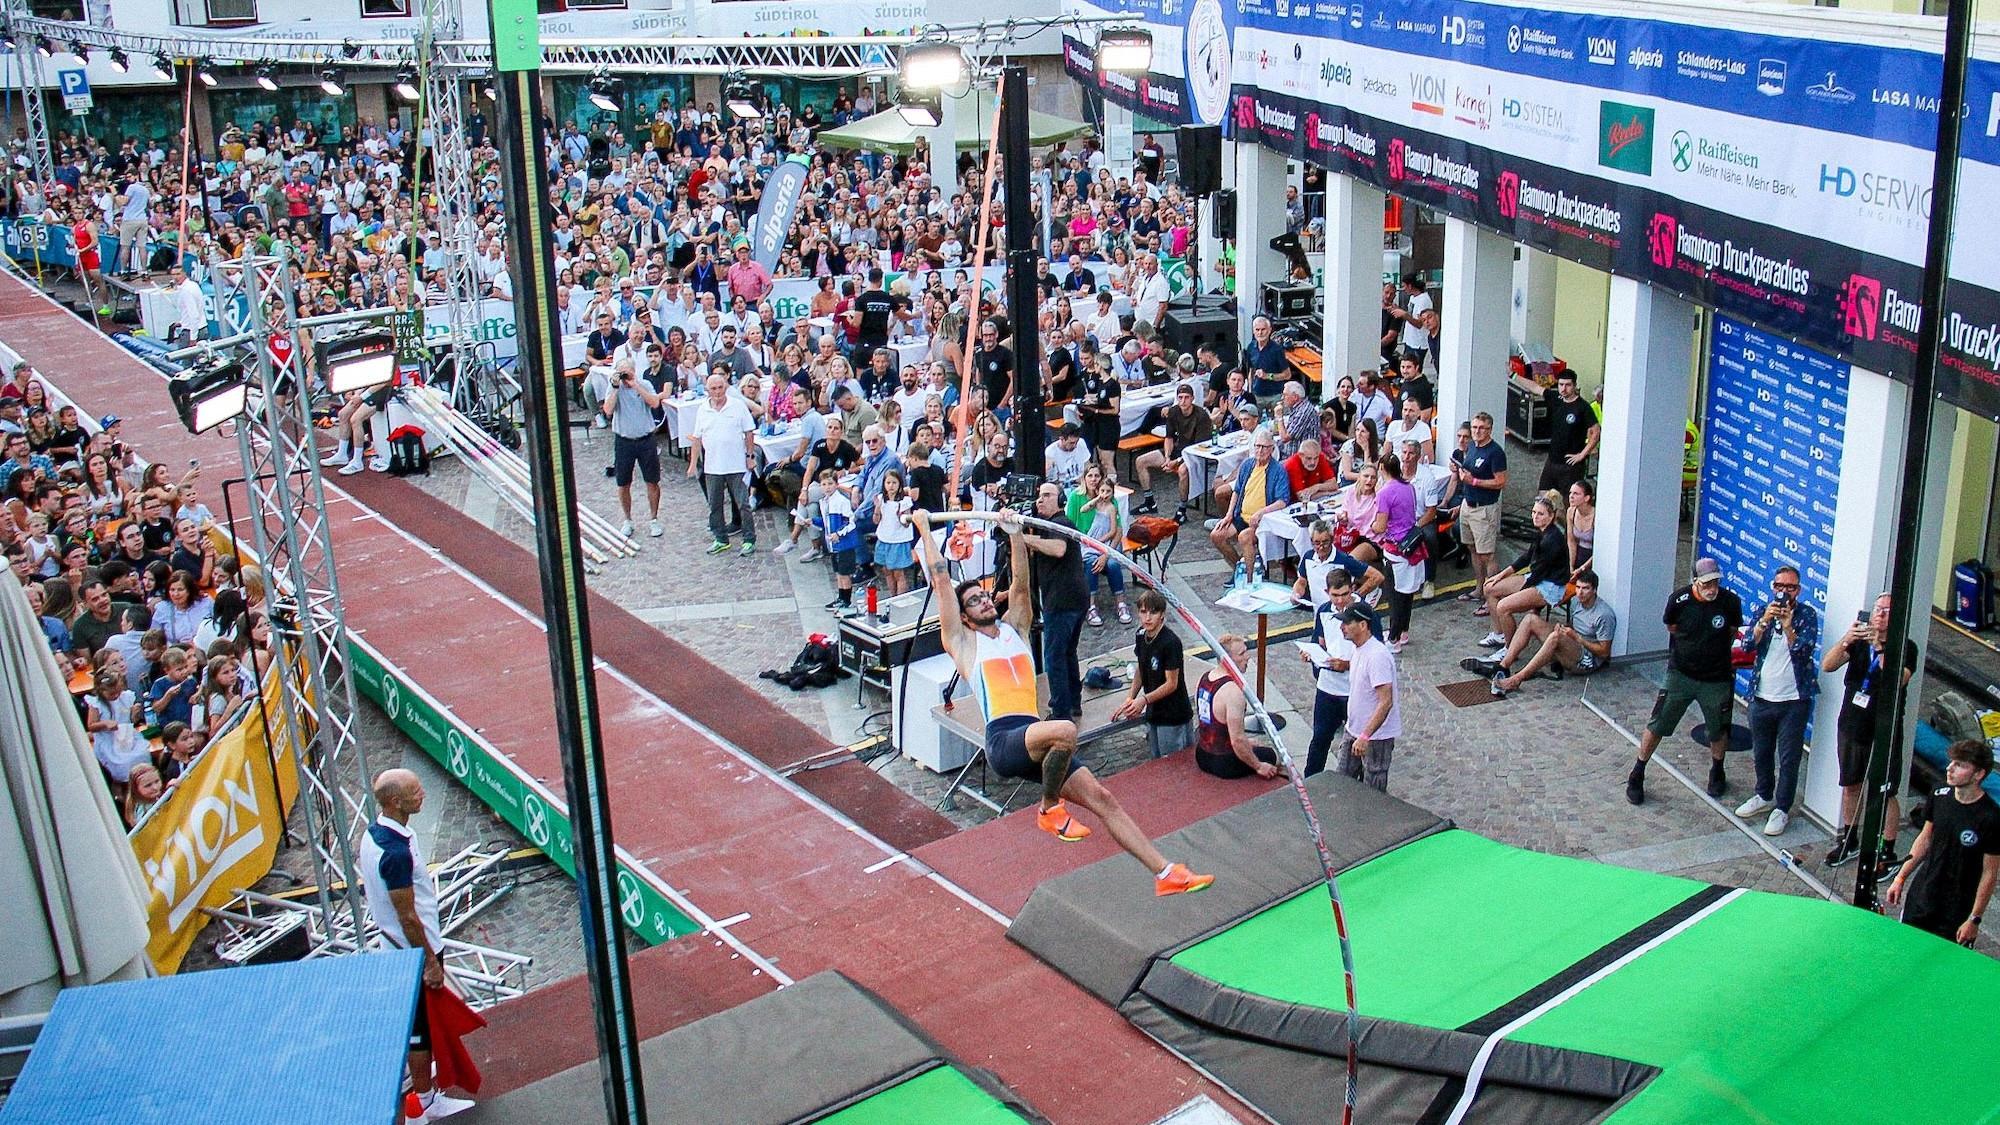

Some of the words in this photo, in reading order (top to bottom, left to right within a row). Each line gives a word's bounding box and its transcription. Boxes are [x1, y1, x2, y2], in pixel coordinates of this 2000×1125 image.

[1397, 21, 1413, 31] LASA
[1441, 16, 1466, 45] HD
[1523, 28, 1557, 45] Raiffeisen
[1588, 37, 1616, 58] VION
[1628, 47, 1664, 70] alperia
[1320, 57, 1352, 87] alperia
[1677, 51, 1746, 75] Schlanders-Laas
[64, 72, 82, 93] P
[1363, 77, 1397, 97] pedacta
[1410, 72, 1446, 104] VION
[1872, 89, 1910, 107] LASA
[1502, 98, 1521, 118] HD
[1523, 101, 1563, 129] SYSTEM
[1699, 138, 1759, 169] Raiffeisen
[1697, 161, 1719, 175] Mehr
[1722, 167, 1744, 184] Nähe.
[1746, 173, 1770, 191] Mehr
[1771, 178, 1798, 198] Bank.
[1819, 163, 1856, 197] HD
[1860, 172, 1934, 220] SERVIC
[764, 173, 796, 253] alperia
[1519, 180, 1556, 217] Flamingo
[1556, 190, 1621, 233] Druckparadies
[1677, 224, 1721, 270] Flamingo
[1723, 240, 1810, 296] Druckparadies
[1710, 272, 1768, 299] Fantastisch
[1772, 292, 1806, 314] Online
[1720, 321, 1733, 335] HD
[1743, 347, 1756, 362] HD
[1757, 388, 1771, 402] HD
[1810, 445, 1824, 461] HD
[1762, 491, 1775, 506] HD
[1785, 537, 1798, 552] HD
